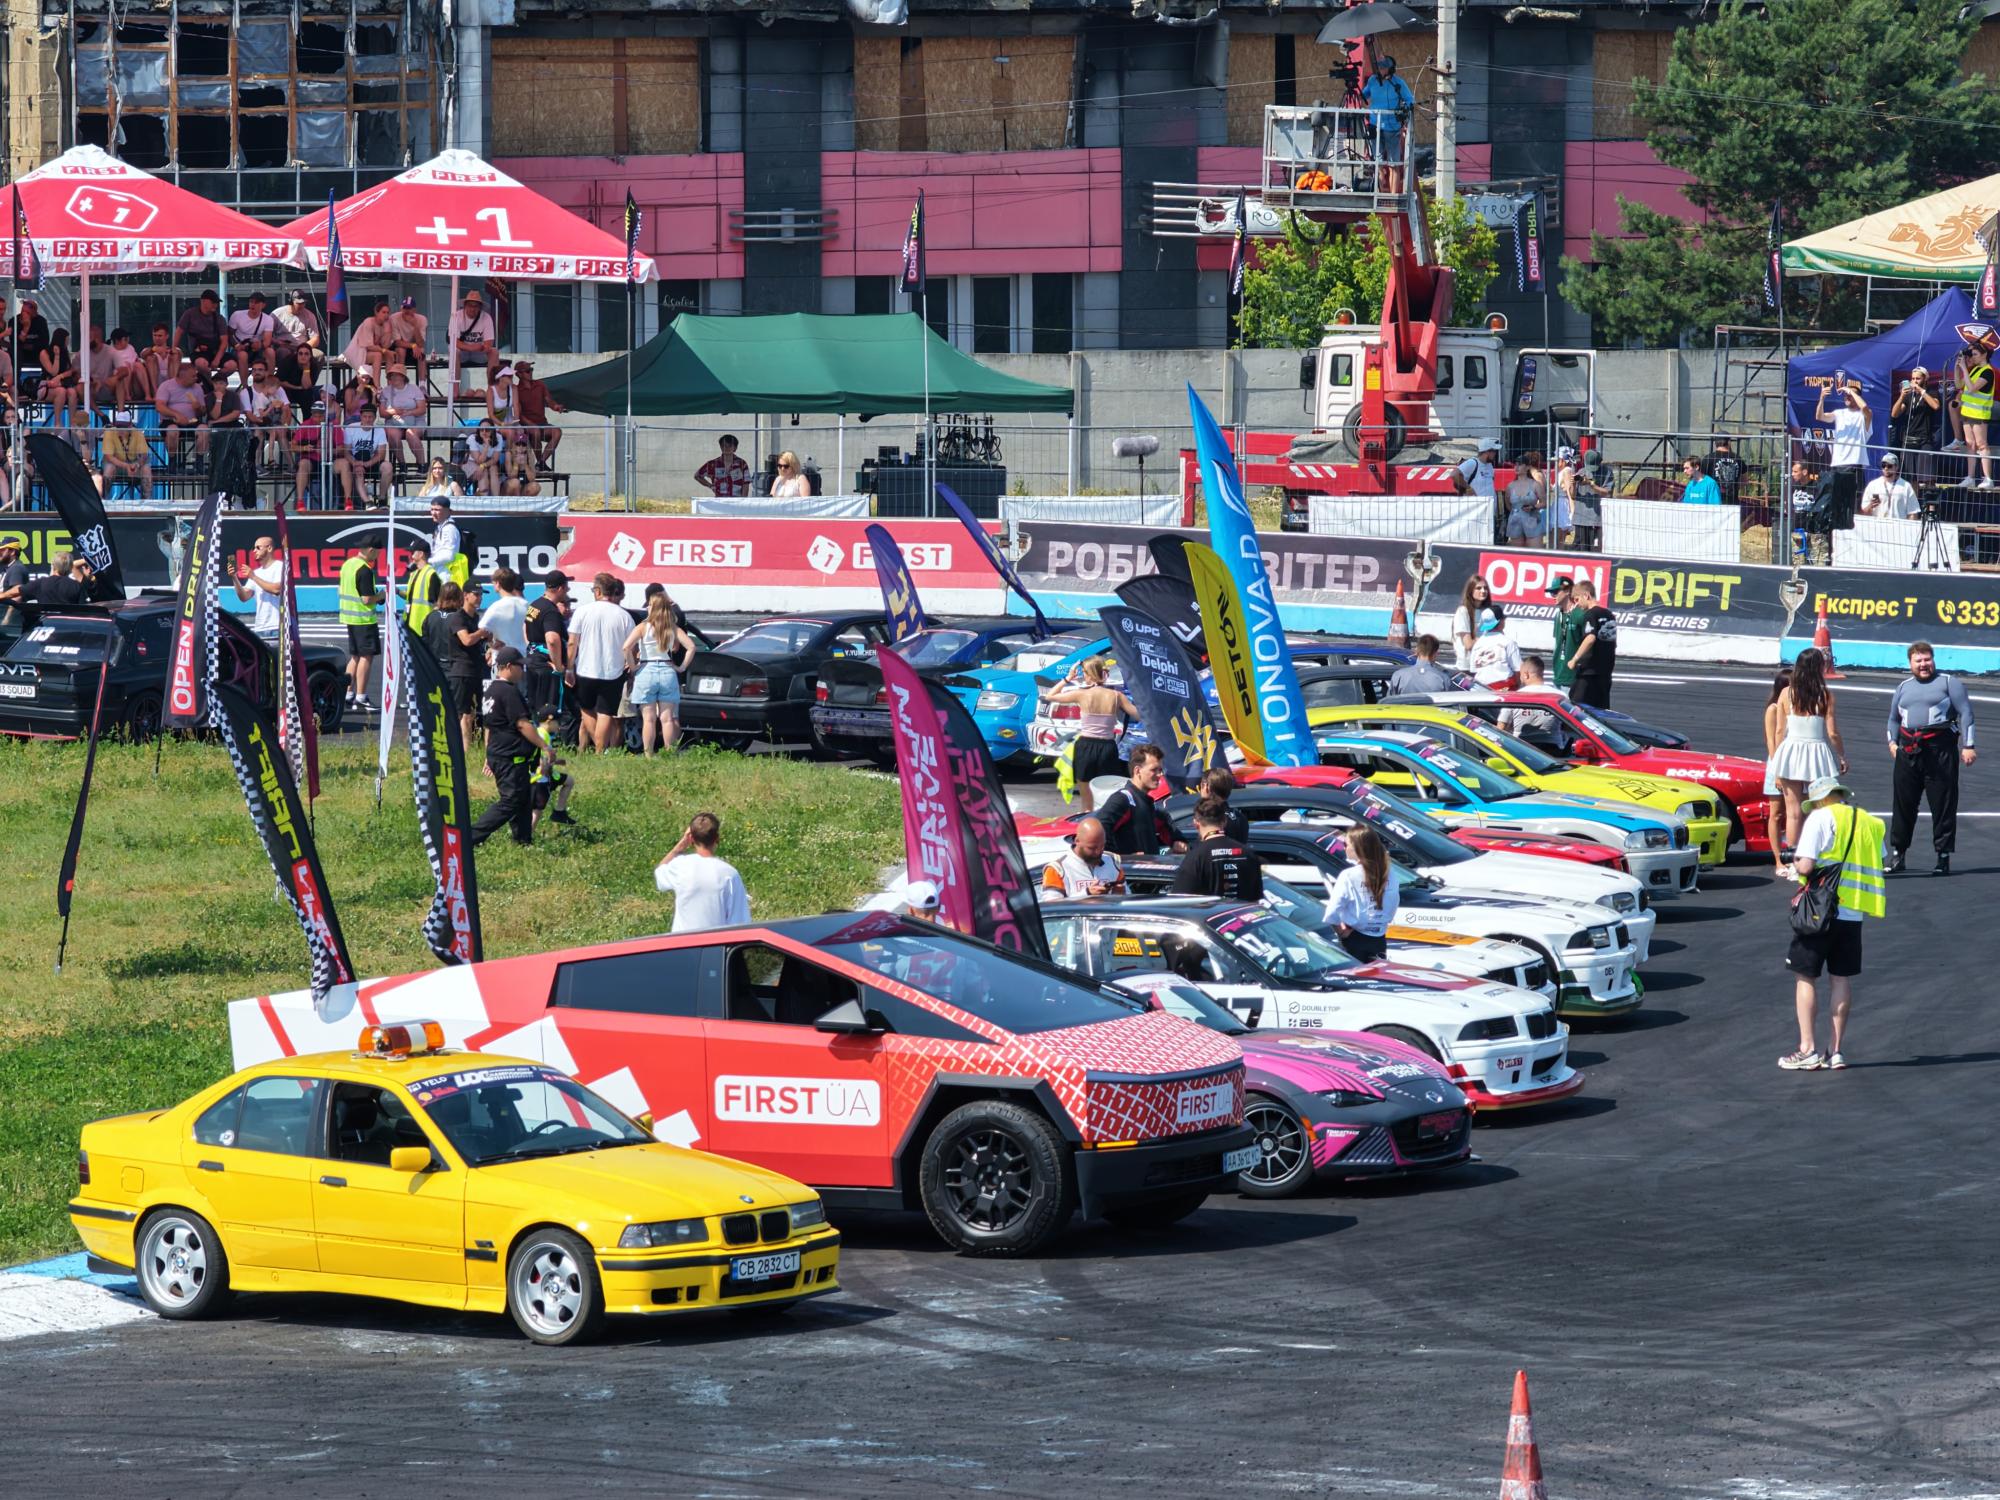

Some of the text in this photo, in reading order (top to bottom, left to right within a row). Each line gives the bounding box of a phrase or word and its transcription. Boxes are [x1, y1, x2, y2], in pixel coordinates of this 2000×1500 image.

[63, 166, 125, 175] FIRST
[434, 170, 495, 182] FIRST
[56, 241, 286, 259] FIRST FIRST FIRST
[318, 252, 378, 267] FRST
[406, 253, 467, 270] FIRST
[492, 256, 552, 273] FIRST
[473, 546, 558, 576] ВТО
[659, 542, 746, 565] FIRST
[184, 527, 204, 618] DRIFT
[1613, 568, 1742, 611] DRIFT
[1135, 623, 1160, 637] UPG
[1650, 614, 1710, 630] SERIES
[1240, 534, 1300, 768] IONOVA-D
[173, 624, 194, 711] OPEN
[1141, 653, 1179, 676] Delphi
[1666, 768, 1731, 780] ROCK OIL
[723, 1084, 820, 1116] FIRST
[1180, 1091, 1217, 1118] FIRST
[757, 1256, 782, 1274] 2832
